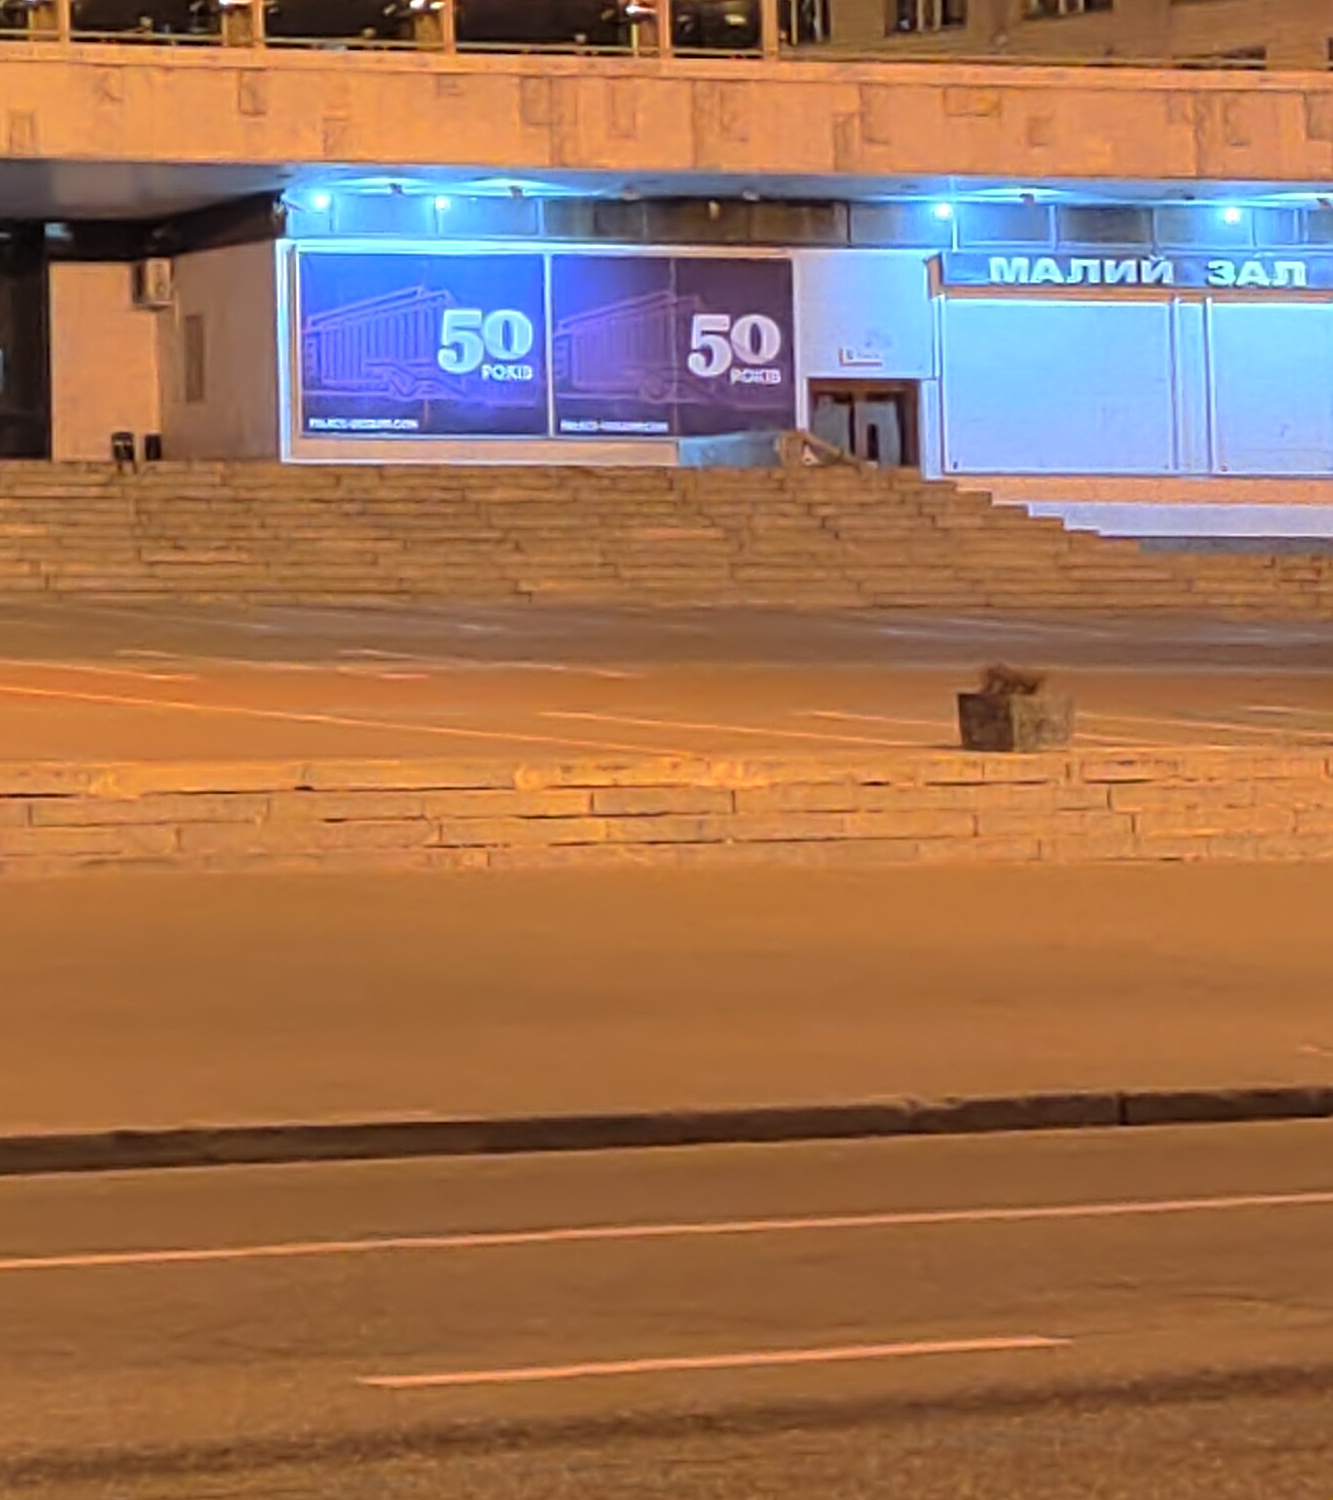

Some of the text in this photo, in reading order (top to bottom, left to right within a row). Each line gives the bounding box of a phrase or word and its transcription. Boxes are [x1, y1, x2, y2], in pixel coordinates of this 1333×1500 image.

[989, 253, 1308, 286] МАЛИЙ ЗАЛ
[437, 308, 533, 374] 50
[688, 314, 781, 377] 50
